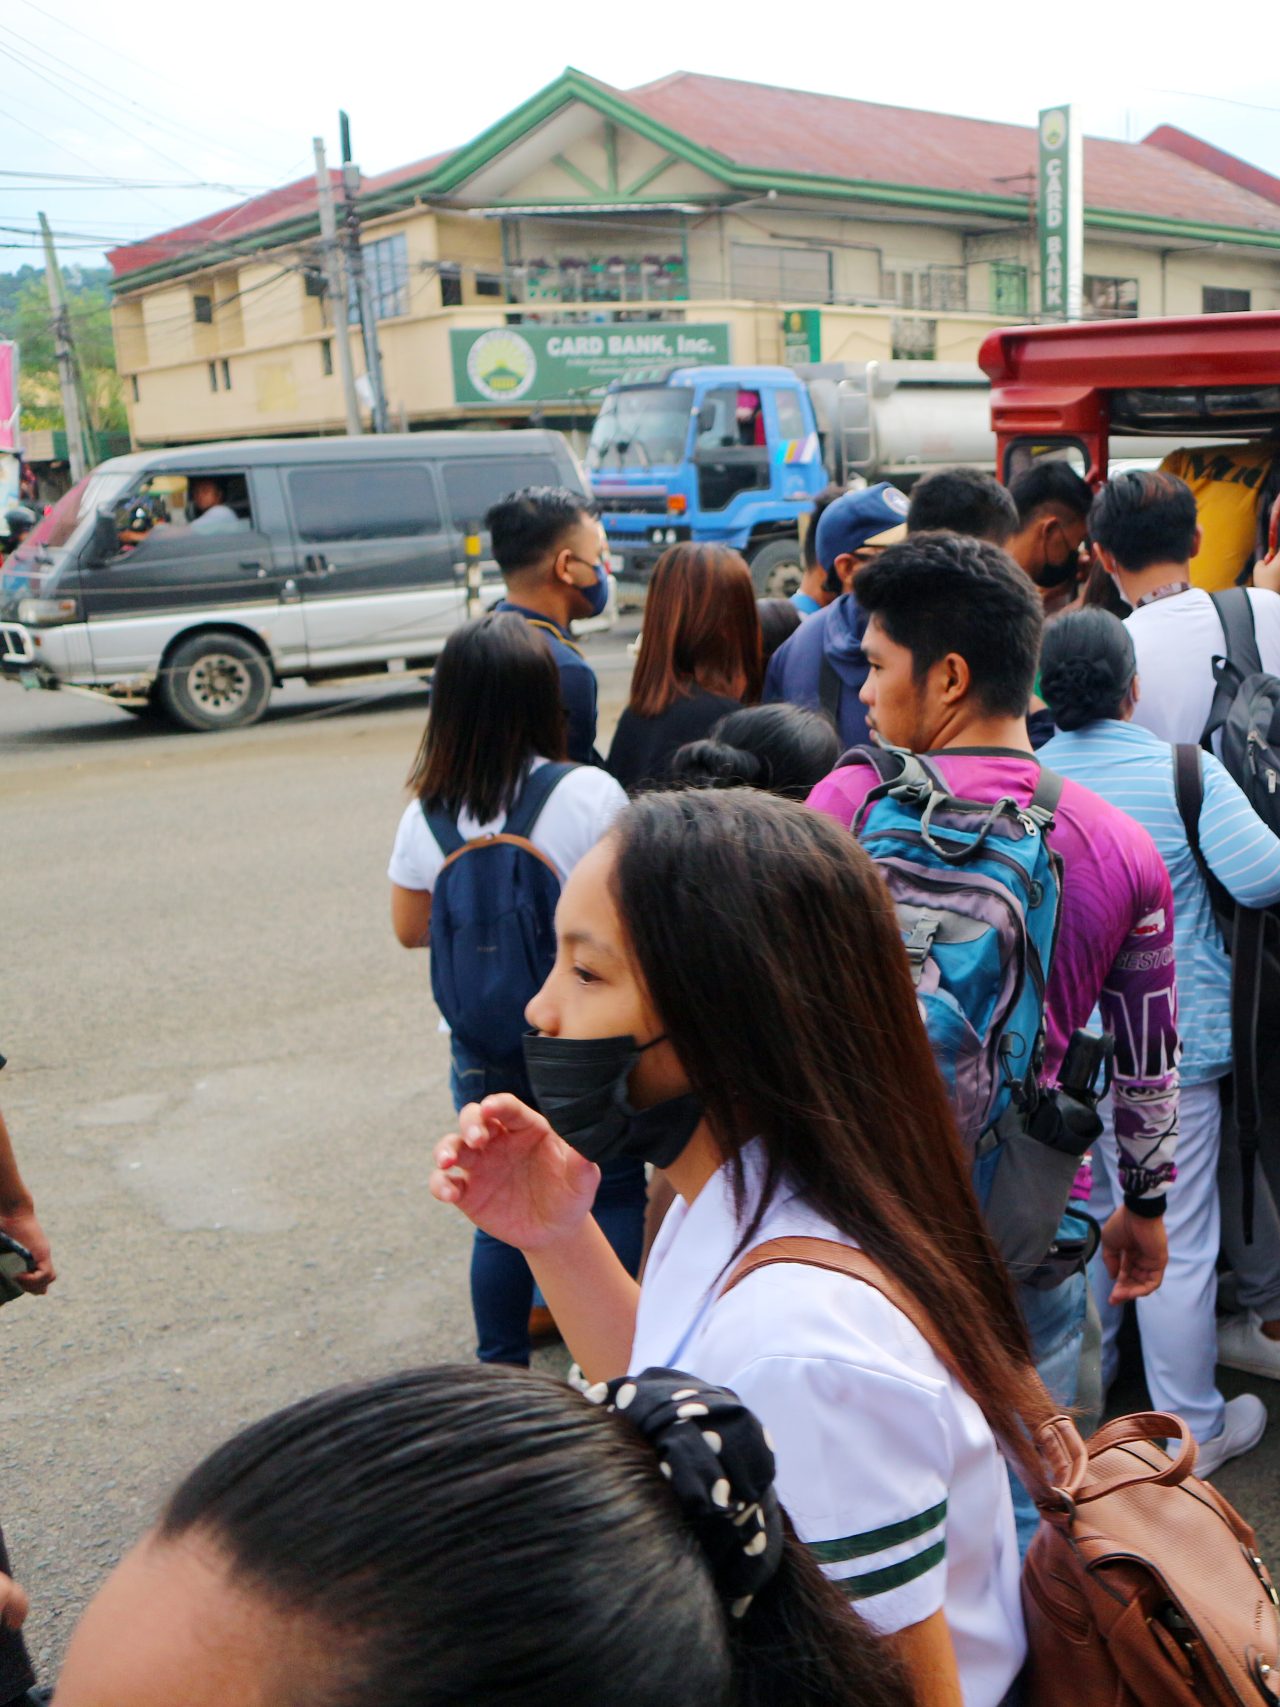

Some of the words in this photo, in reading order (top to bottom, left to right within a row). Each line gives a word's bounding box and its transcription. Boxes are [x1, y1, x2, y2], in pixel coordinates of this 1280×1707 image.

[1046, 158, 1063, 230] CARD
[1046, 235, 1063, 306] BANK
[546, 336, 604, 357] CARD
[608, 334, 673, 355] BANK,
[677, 334, 716, 353] Inc.
